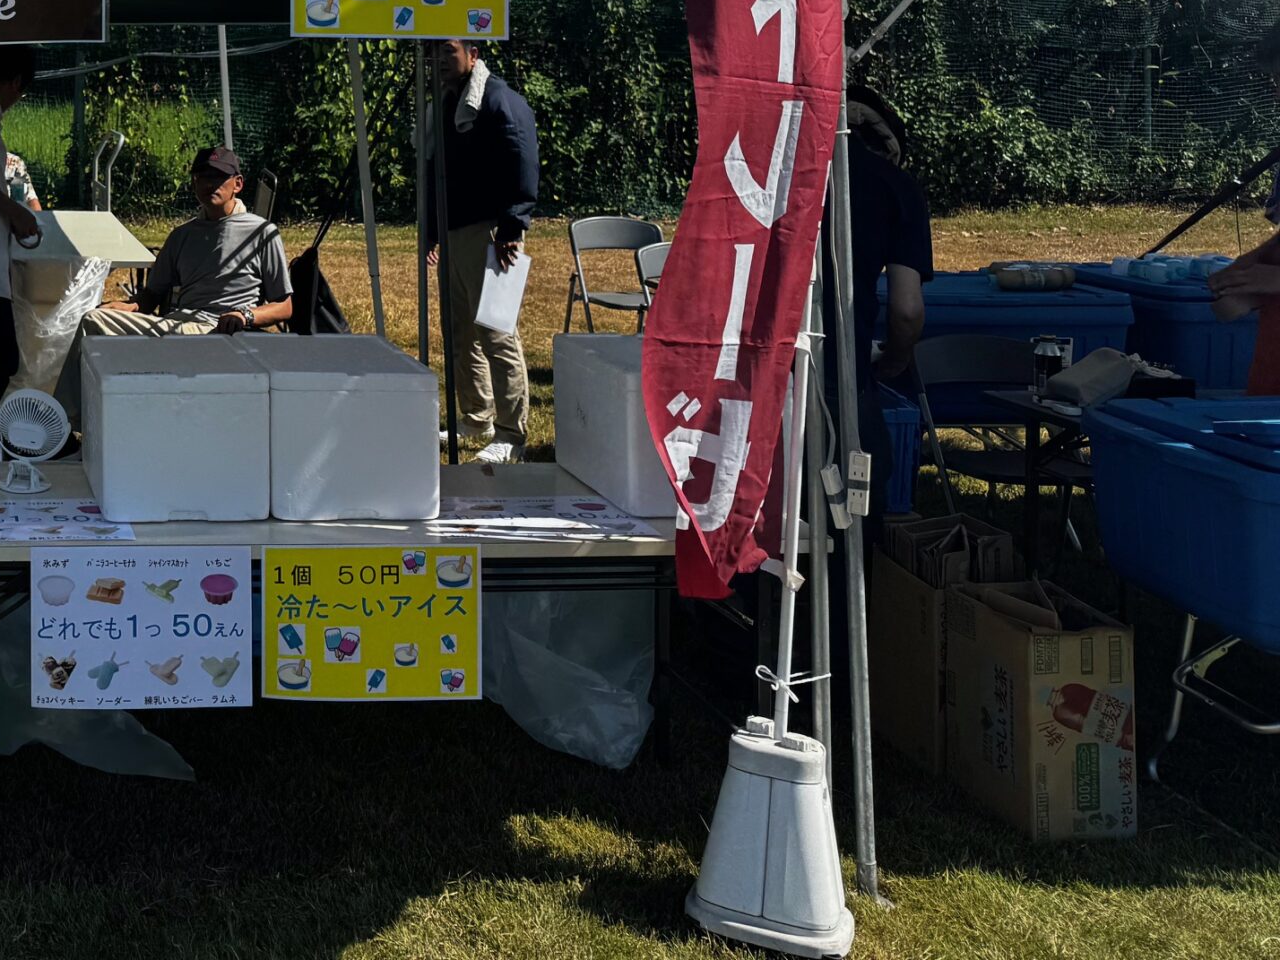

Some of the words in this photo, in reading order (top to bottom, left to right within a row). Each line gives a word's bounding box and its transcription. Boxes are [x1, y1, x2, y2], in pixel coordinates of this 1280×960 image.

[42, 558, 70, 569] 氷みず
[205, 557, 232, 568] いちご
[273, 565, 311, 586] 1個
[338, 564, 400, 585] 50円
[96, 696, 132, 706] ソーダー
[211, 693, 237, 704] ラムネ
[1078, 775, 1090, 808] 100%
[1118, 756, 1133, 828] やさしい麦茶
